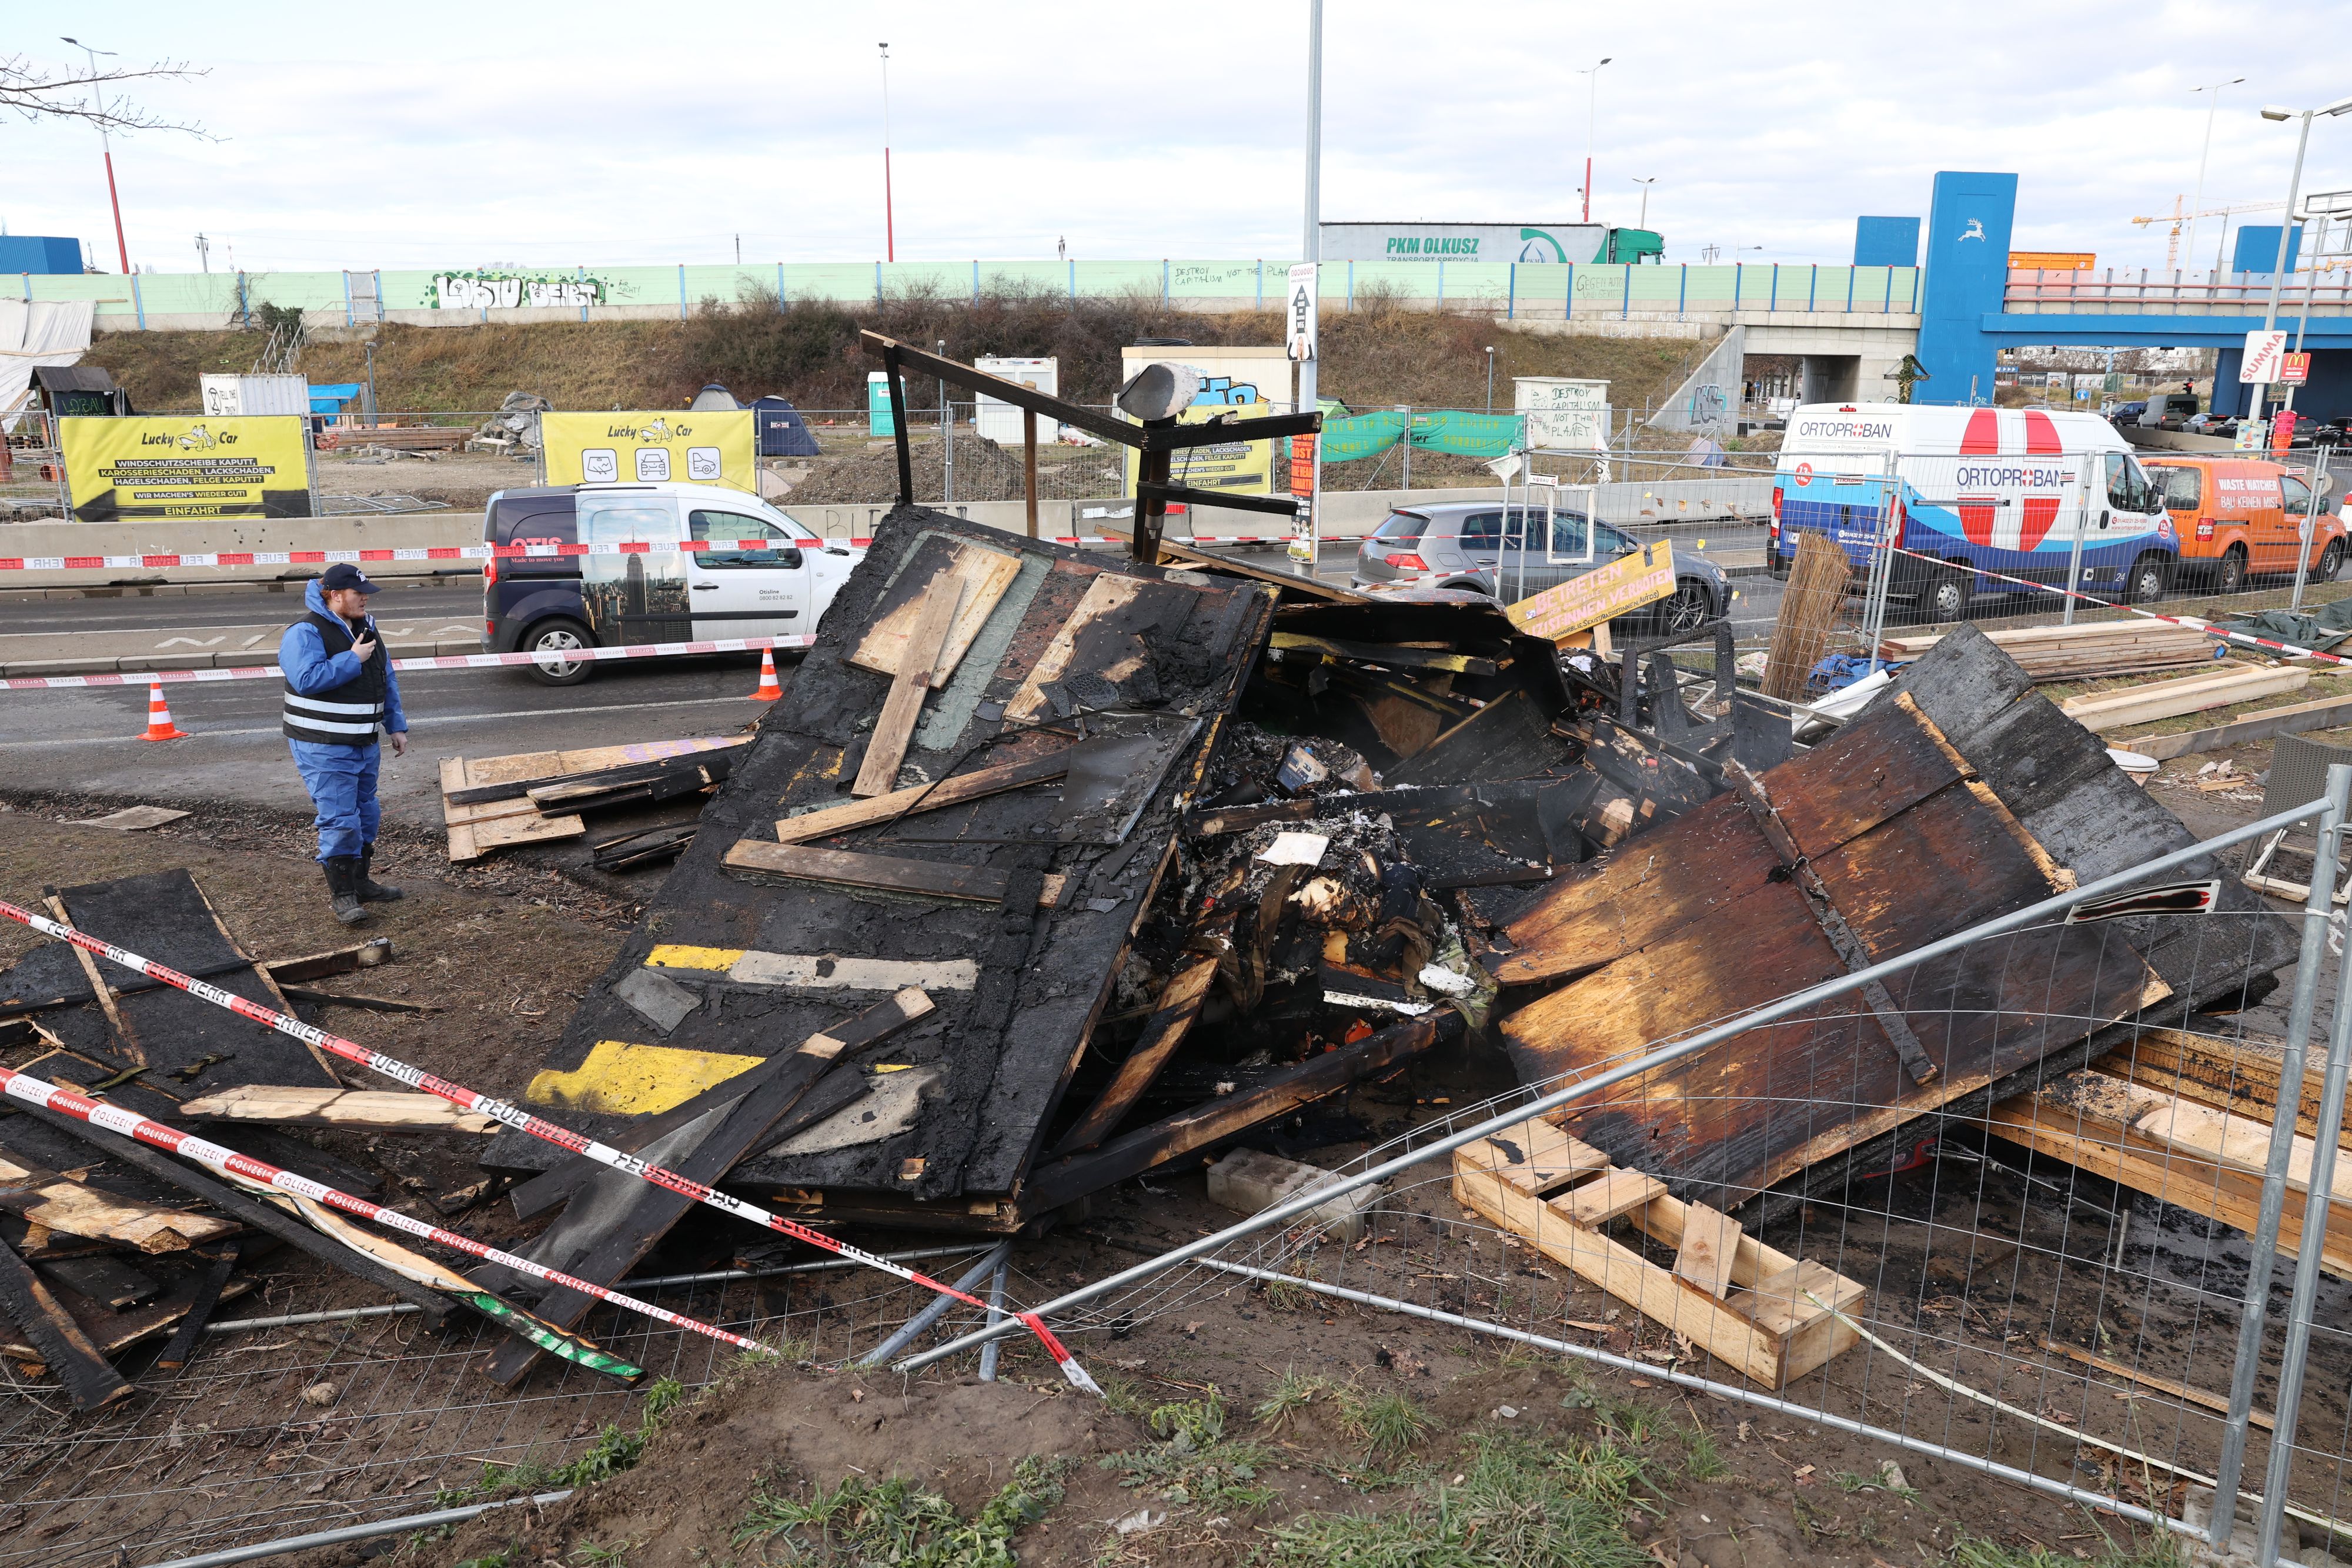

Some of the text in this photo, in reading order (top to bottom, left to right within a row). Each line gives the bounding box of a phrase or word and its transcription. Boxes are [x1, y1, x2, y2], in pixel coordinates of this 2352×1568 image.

[1387, 238, 1479, 254] PKM OLKUSZ
[1175, 266, 1210, 276] DESTROY
[1227, 269, 1242, 278] NOT
[1267, 265, 1289, 276] PLAN
[1175, 275, 1222, 286] CAPITALISM
[1576, 275, 1606, 291] GEGEN
[1602, 312, 1628, 321] LIEBE
[1629, 312, 1655, 321] STATT
[1600, 323, 1643, 339] LOBAU
[2242, 334, 2284, 380] SUMMA
[1552, 387, 1590, 400] DESTROY
[1552, 401, 1600, 412] CAPITALISM
[1553, 413, 1593, 423] NOT THE
[607, 424, 693, 440] Lucky Car
[1552, 422, 1590, 437] PLANET
[142, 432, 238, 447] Lucky Car
[117, 458, 256, 467] WINDSCHUTZSCHEIBE KAPUTT,
[101, 468, 203, 477] KAROSSERIESCHADEN,
[115, 477, 192, 486] HAGELSCHADEN,
[222, 475, 262, 483] KAPUTT?
[2218, 479, 2278, 491] WASTE WATCHER
[2221, 497, 2235, 508] BAU
[2237, 497, 2261, 508] KEINEN
[165, 506, 221, 515] EINFAHRT
[2115, 573, 2126, 582] 24
[1535, 562, 1623, 616] BETRETEN
[1609, 567, 1673, 606] VERBOTEN
[243, 1002, 338, 1049] FEUERWEHR
[355, 1048, 464, 1099] FEUERWEHR
[11, 1080, 726, 1340] POLIZEI POLIZEI POLIZEI POLIZEI POLIZEI POLIZEI POLIZEI POLIZEI POLIZEI POLIZEI POLIZEI POLIZEI POLIZEI POLIZEI
